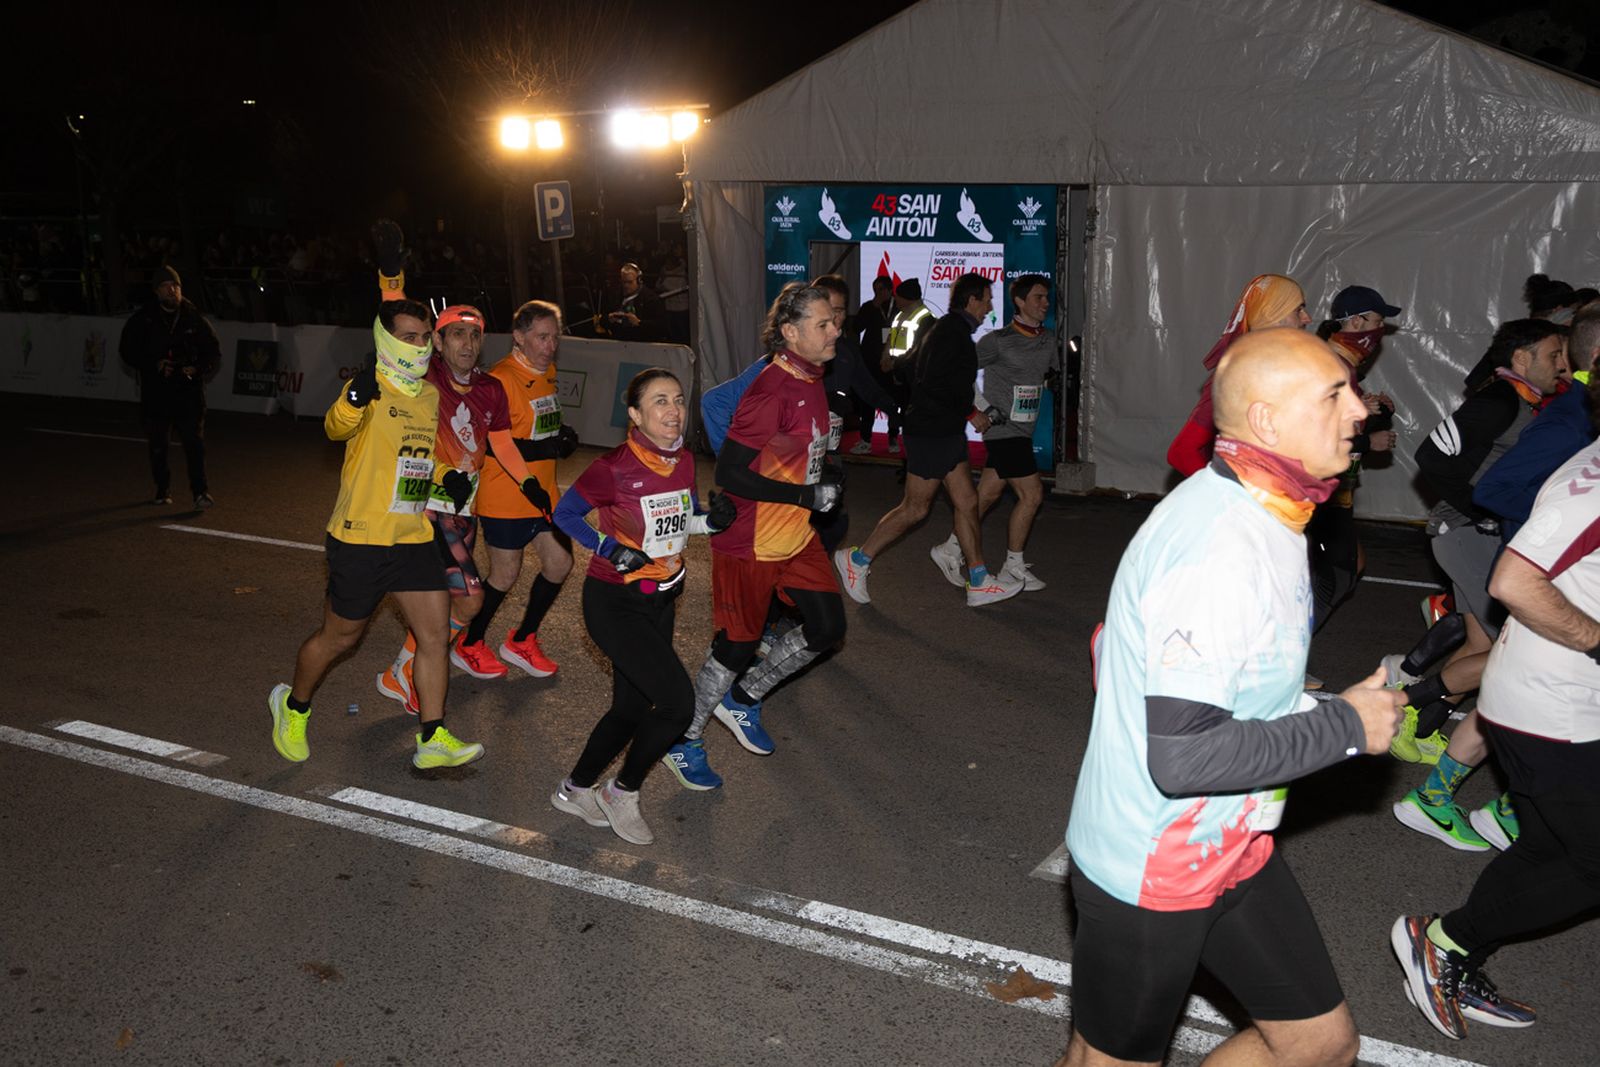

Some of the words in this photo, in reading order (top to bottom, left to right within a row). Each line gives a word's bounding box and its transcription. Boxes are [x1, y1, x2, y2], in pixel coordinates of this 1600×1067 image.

[543, 188, 565, 233] P
[871, 193, 897, 216] 43
[898, 193, 941, 215] SAN
[828, 216, 841, 232] 43
[865, 212, 937, 237] ANTÓN
[967, 217, 981, 234] 43
[767, 262, 805, 272] calderón
[934, 258, 957, 266] NOCHE
[957, 258, 967, 266] DE
[931, 265, 965, 281] SAN
[458, 426, 473, 442] 43
[655, 512, 687, 537] 3296
